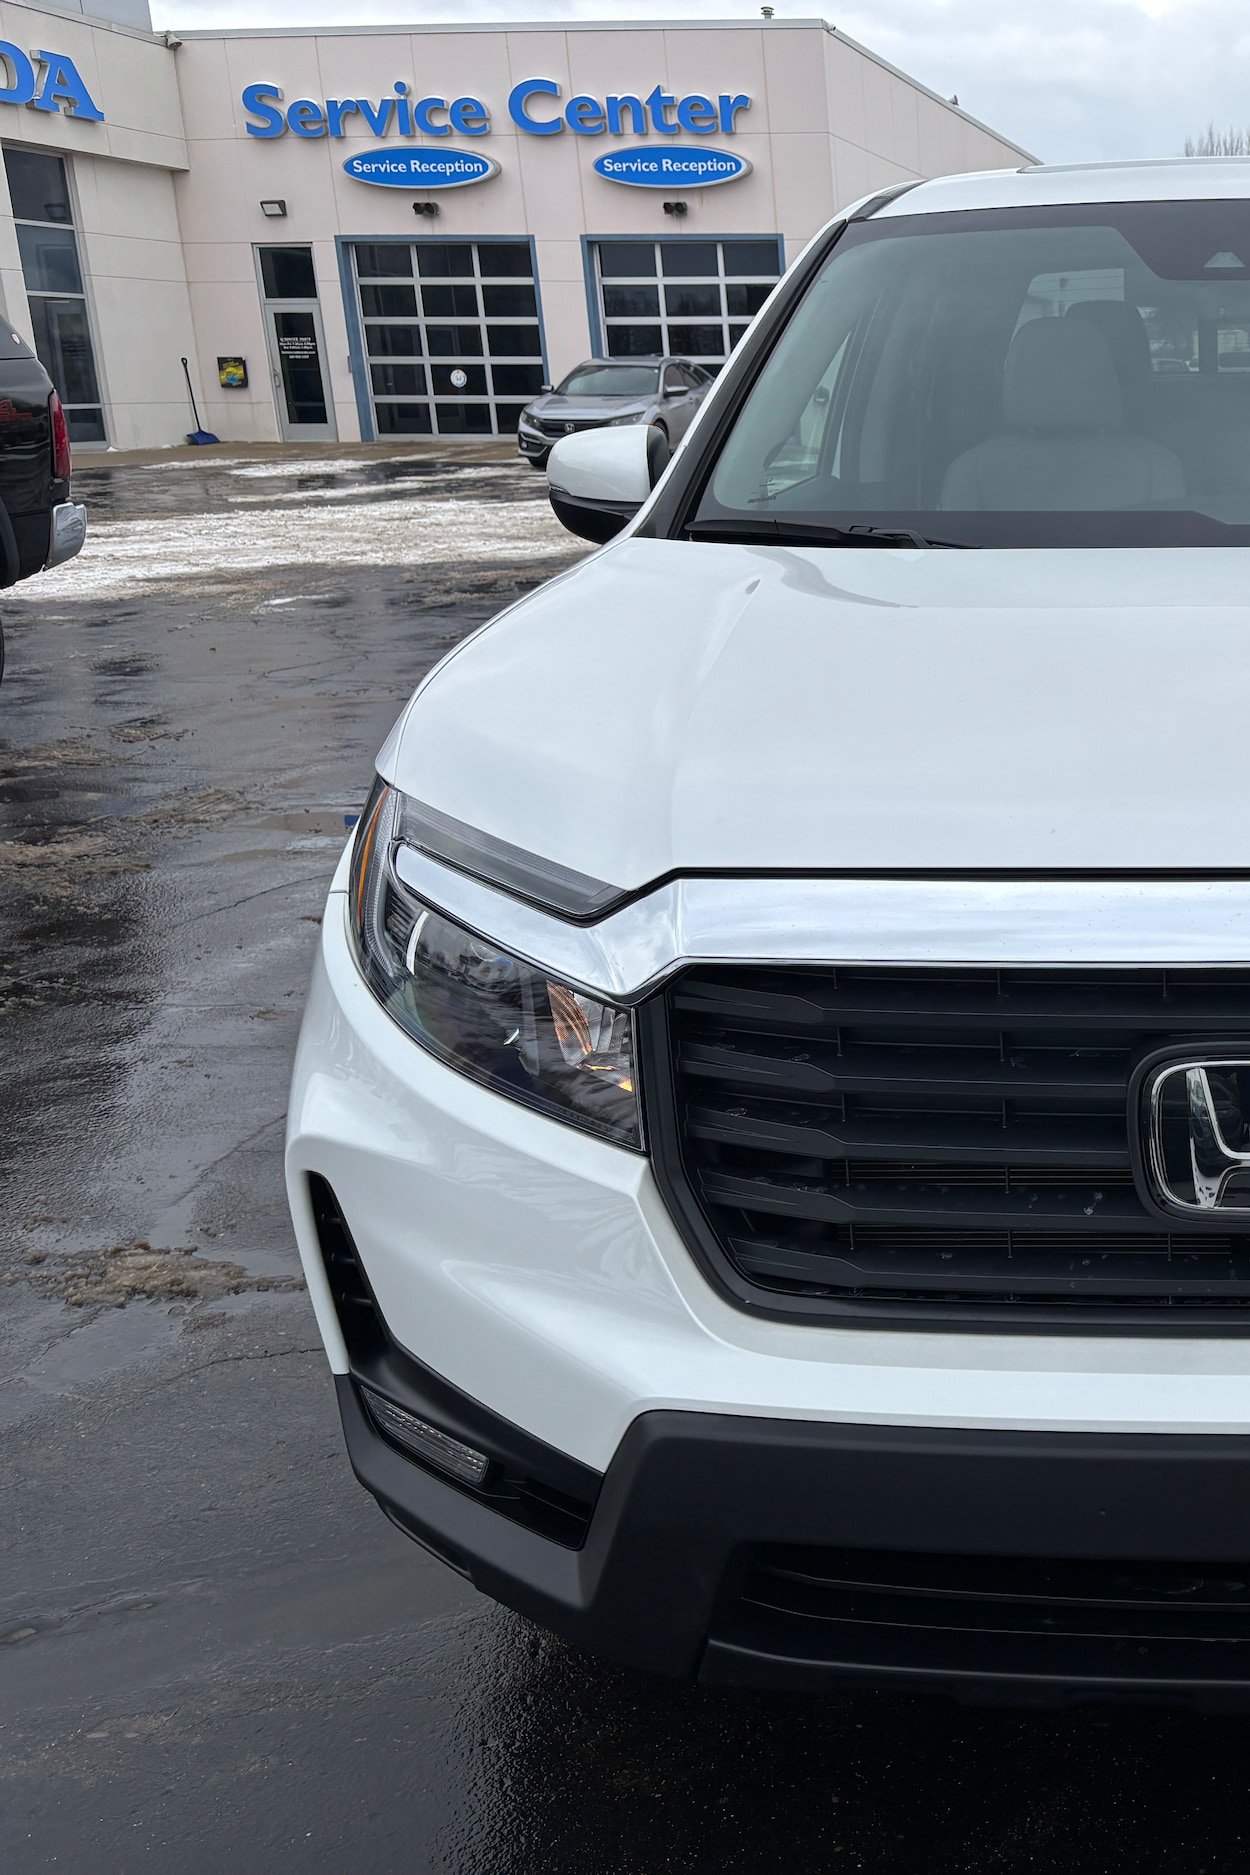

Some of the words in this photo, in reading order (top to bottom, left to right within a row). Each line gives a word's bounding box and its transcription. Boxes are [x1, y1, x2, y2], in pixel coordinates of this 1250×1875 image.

[242, 80, 489, 138] Service
[508, 76, 751, 135] Center
[352, 160, 407, 173] Service
[410, 160, 483, 176] Reception
[603, 159, 658, 172] Service
[662, 158, 736, 175] Reception
